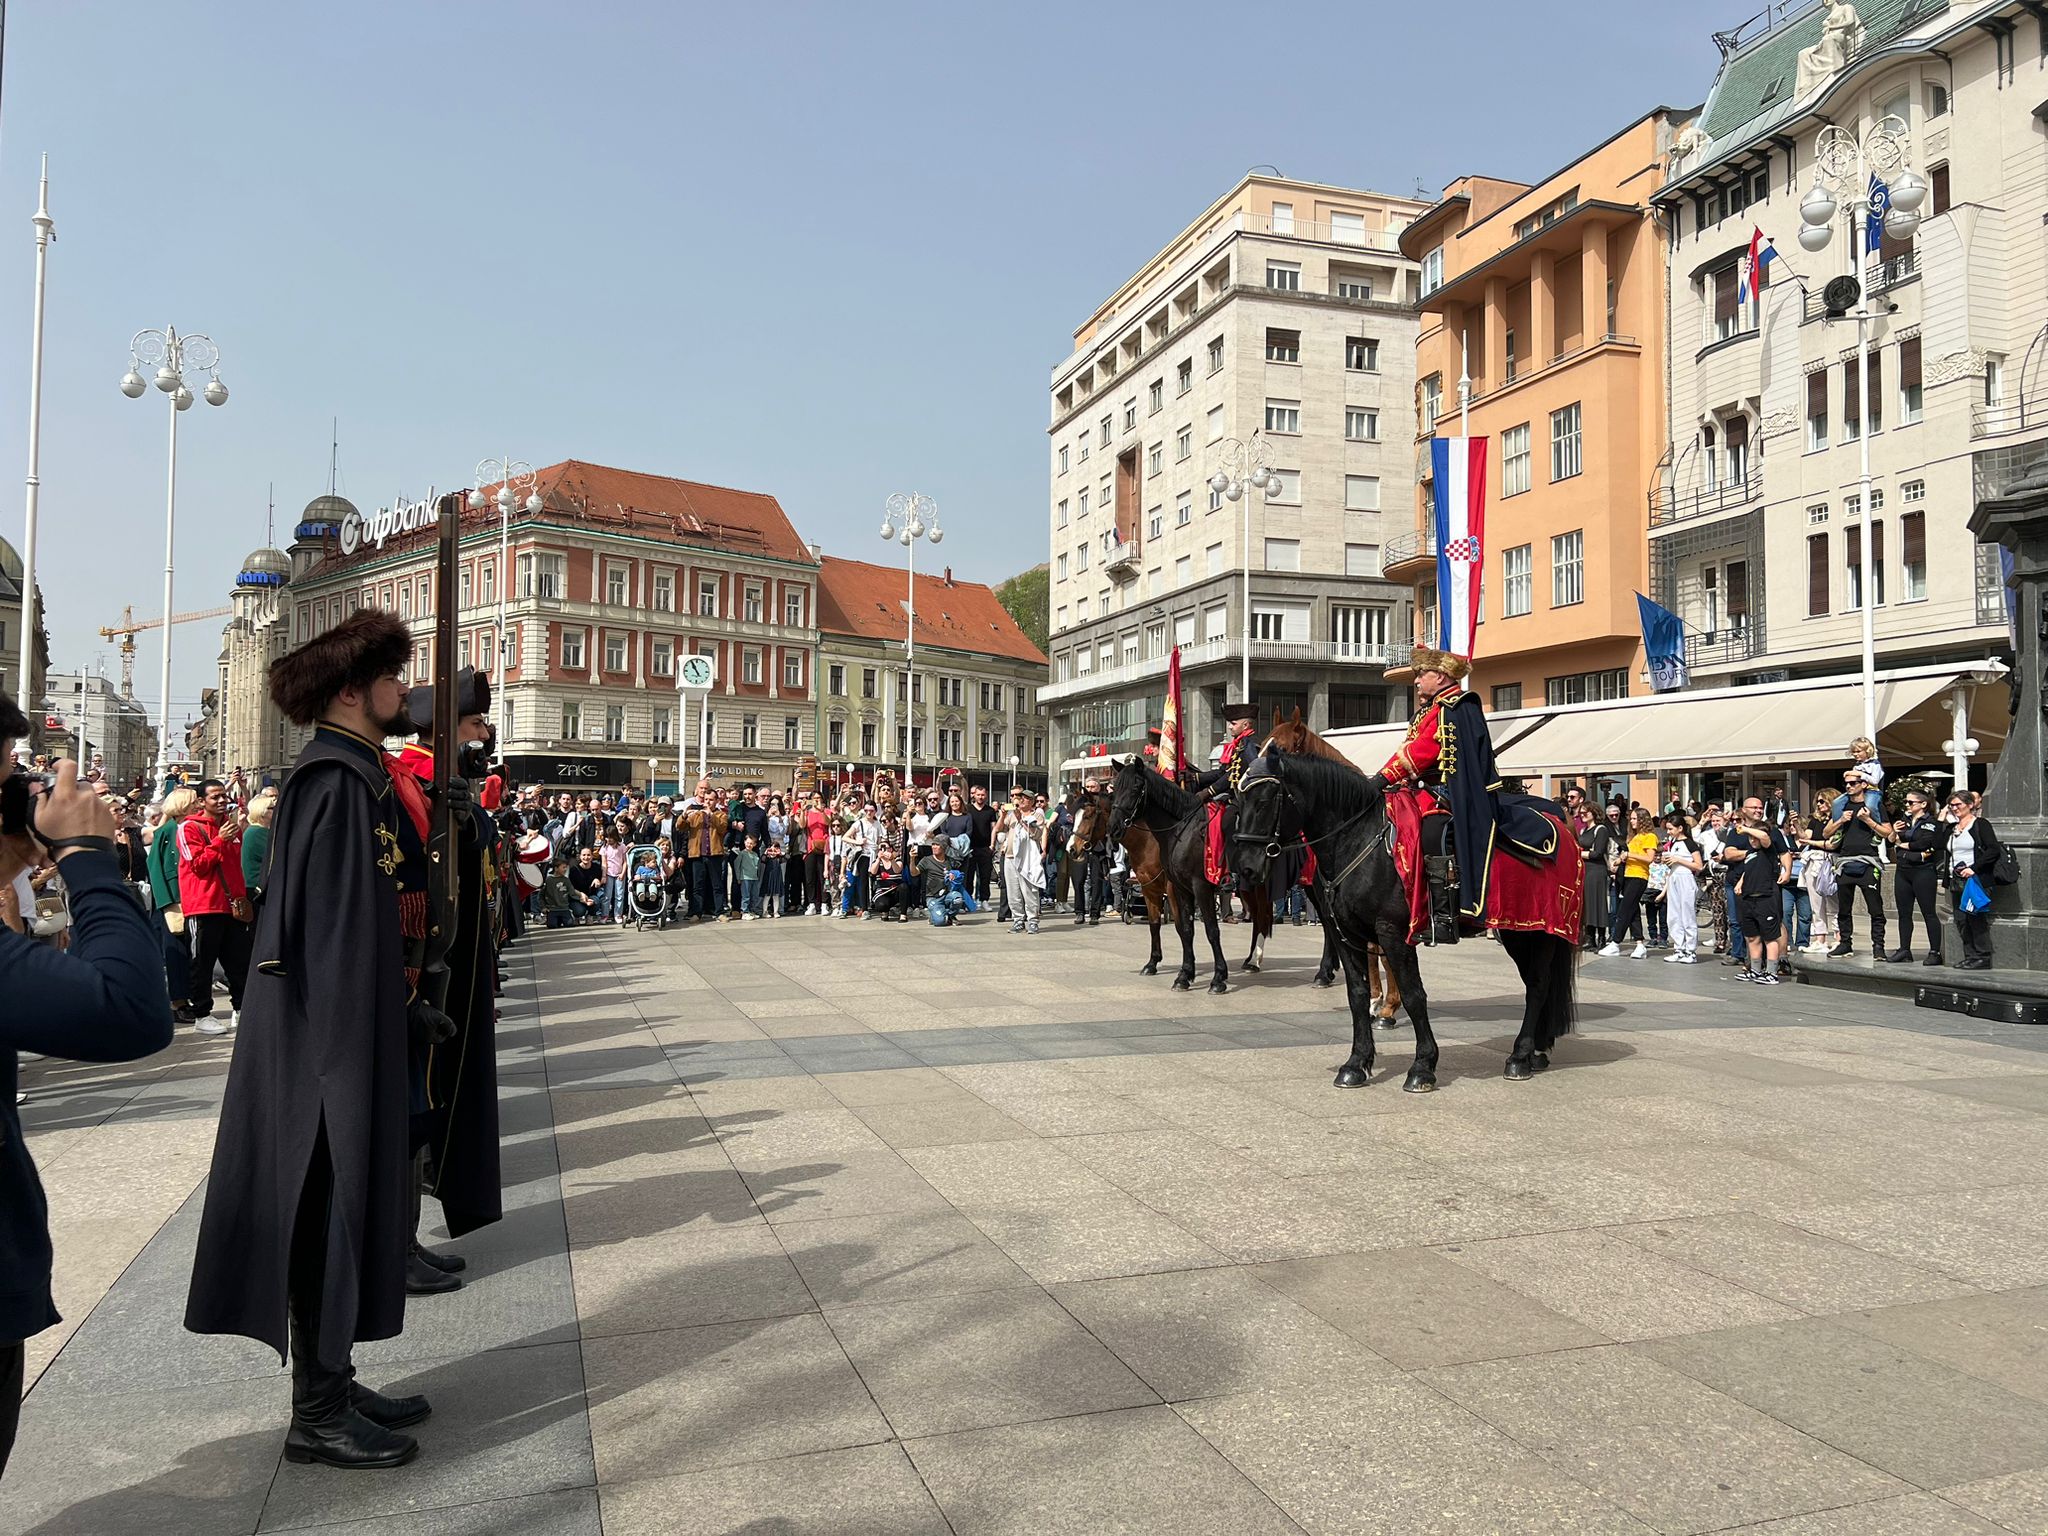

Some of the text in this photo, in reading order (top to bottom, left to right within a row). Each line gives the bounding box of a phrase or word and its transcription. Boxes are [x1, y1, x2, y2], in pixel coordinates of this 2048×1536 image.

[1653, 668, 1688, 681] TOURS
[558, 764, 598, 777] ZAKS
[711, 766, 764, 776] HOLDING
